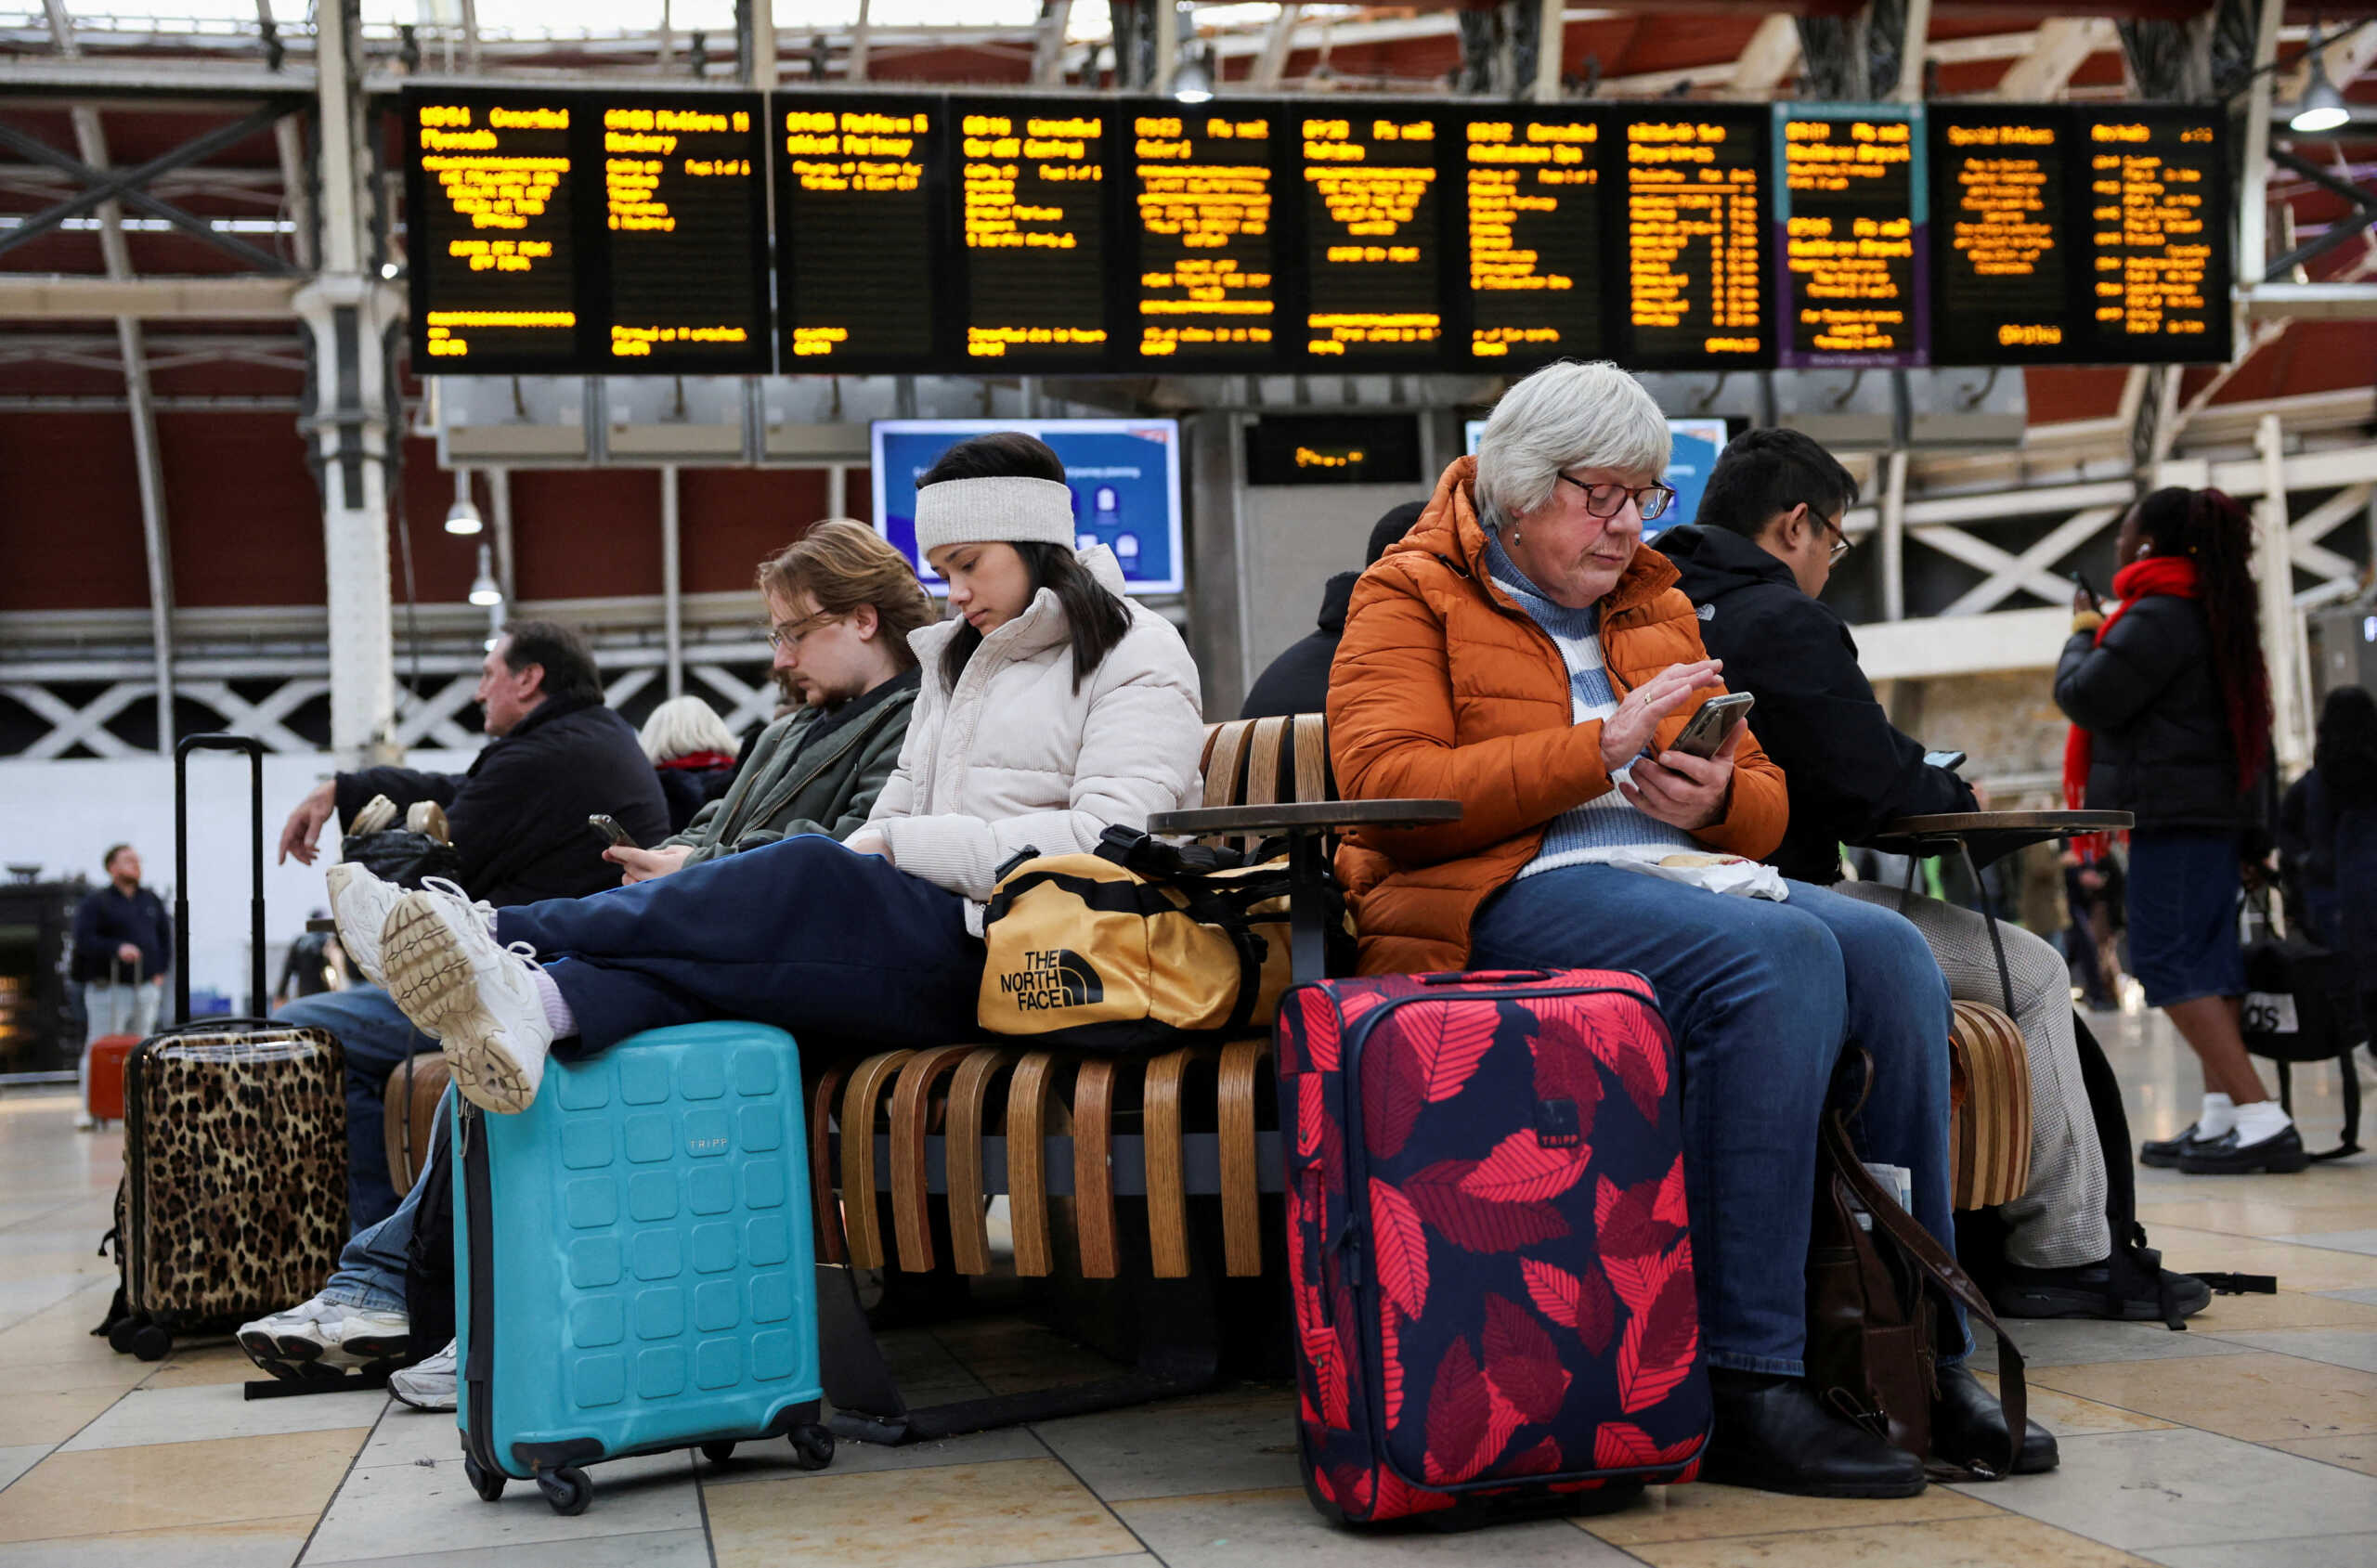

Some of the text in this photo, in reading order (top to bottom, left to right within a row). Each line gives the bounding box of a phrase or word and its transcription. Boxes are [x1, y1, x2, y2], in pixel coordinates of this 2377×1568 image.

[1025, 950, 1059, 970] THE
[1000, 969, 1060, 992] NORTH
[1018, 990, 1062, 1011] FACE
[690, 1138, 728, 1148] TRIPP
[1541, 1134, 1578, 1145] TRIPP
